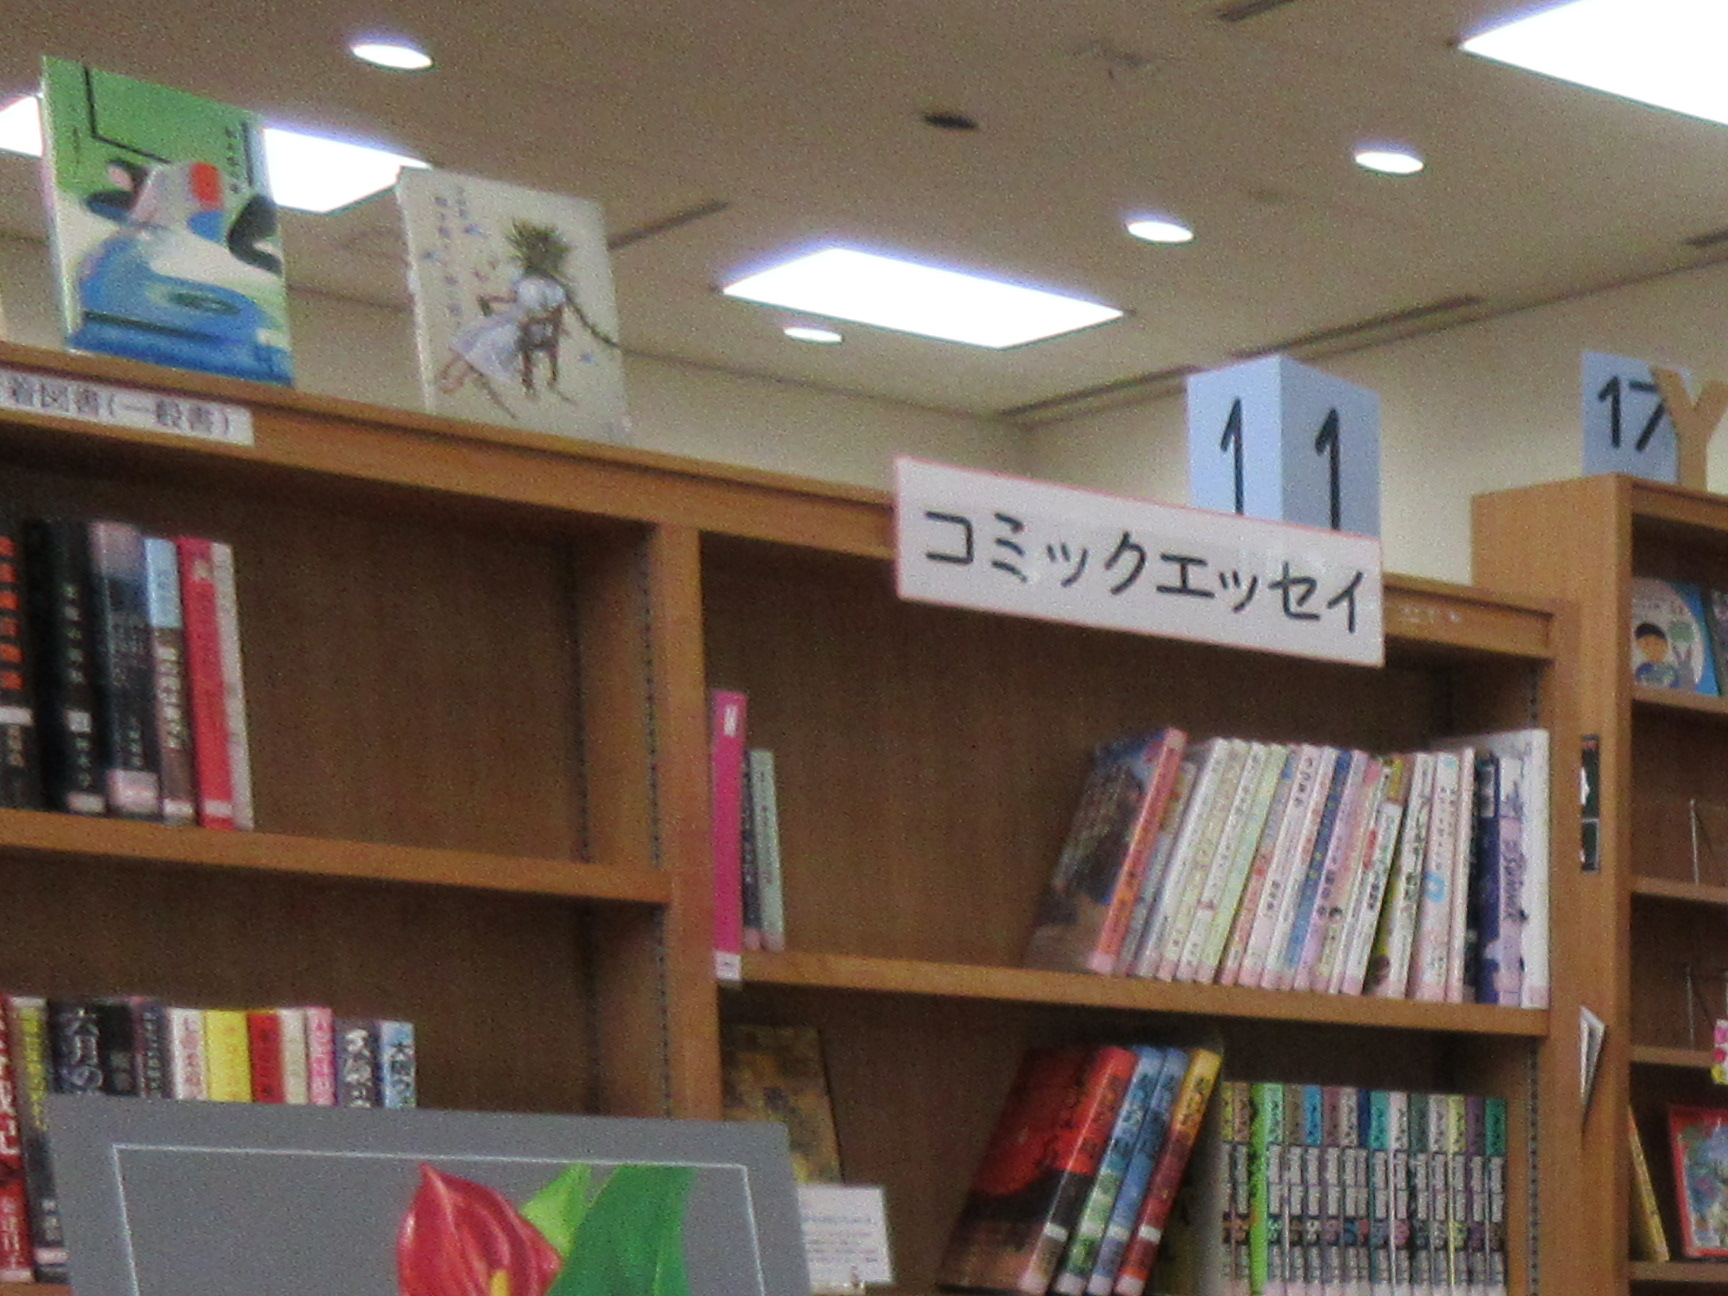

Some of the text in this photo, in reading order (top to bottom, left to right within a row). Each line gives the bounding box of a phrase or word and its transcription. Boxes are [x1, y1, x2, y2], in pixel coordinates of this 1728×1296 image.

[1599, 375, 1668, 453] 17
[924, 510, 1368, 633] コミックエッセイ
